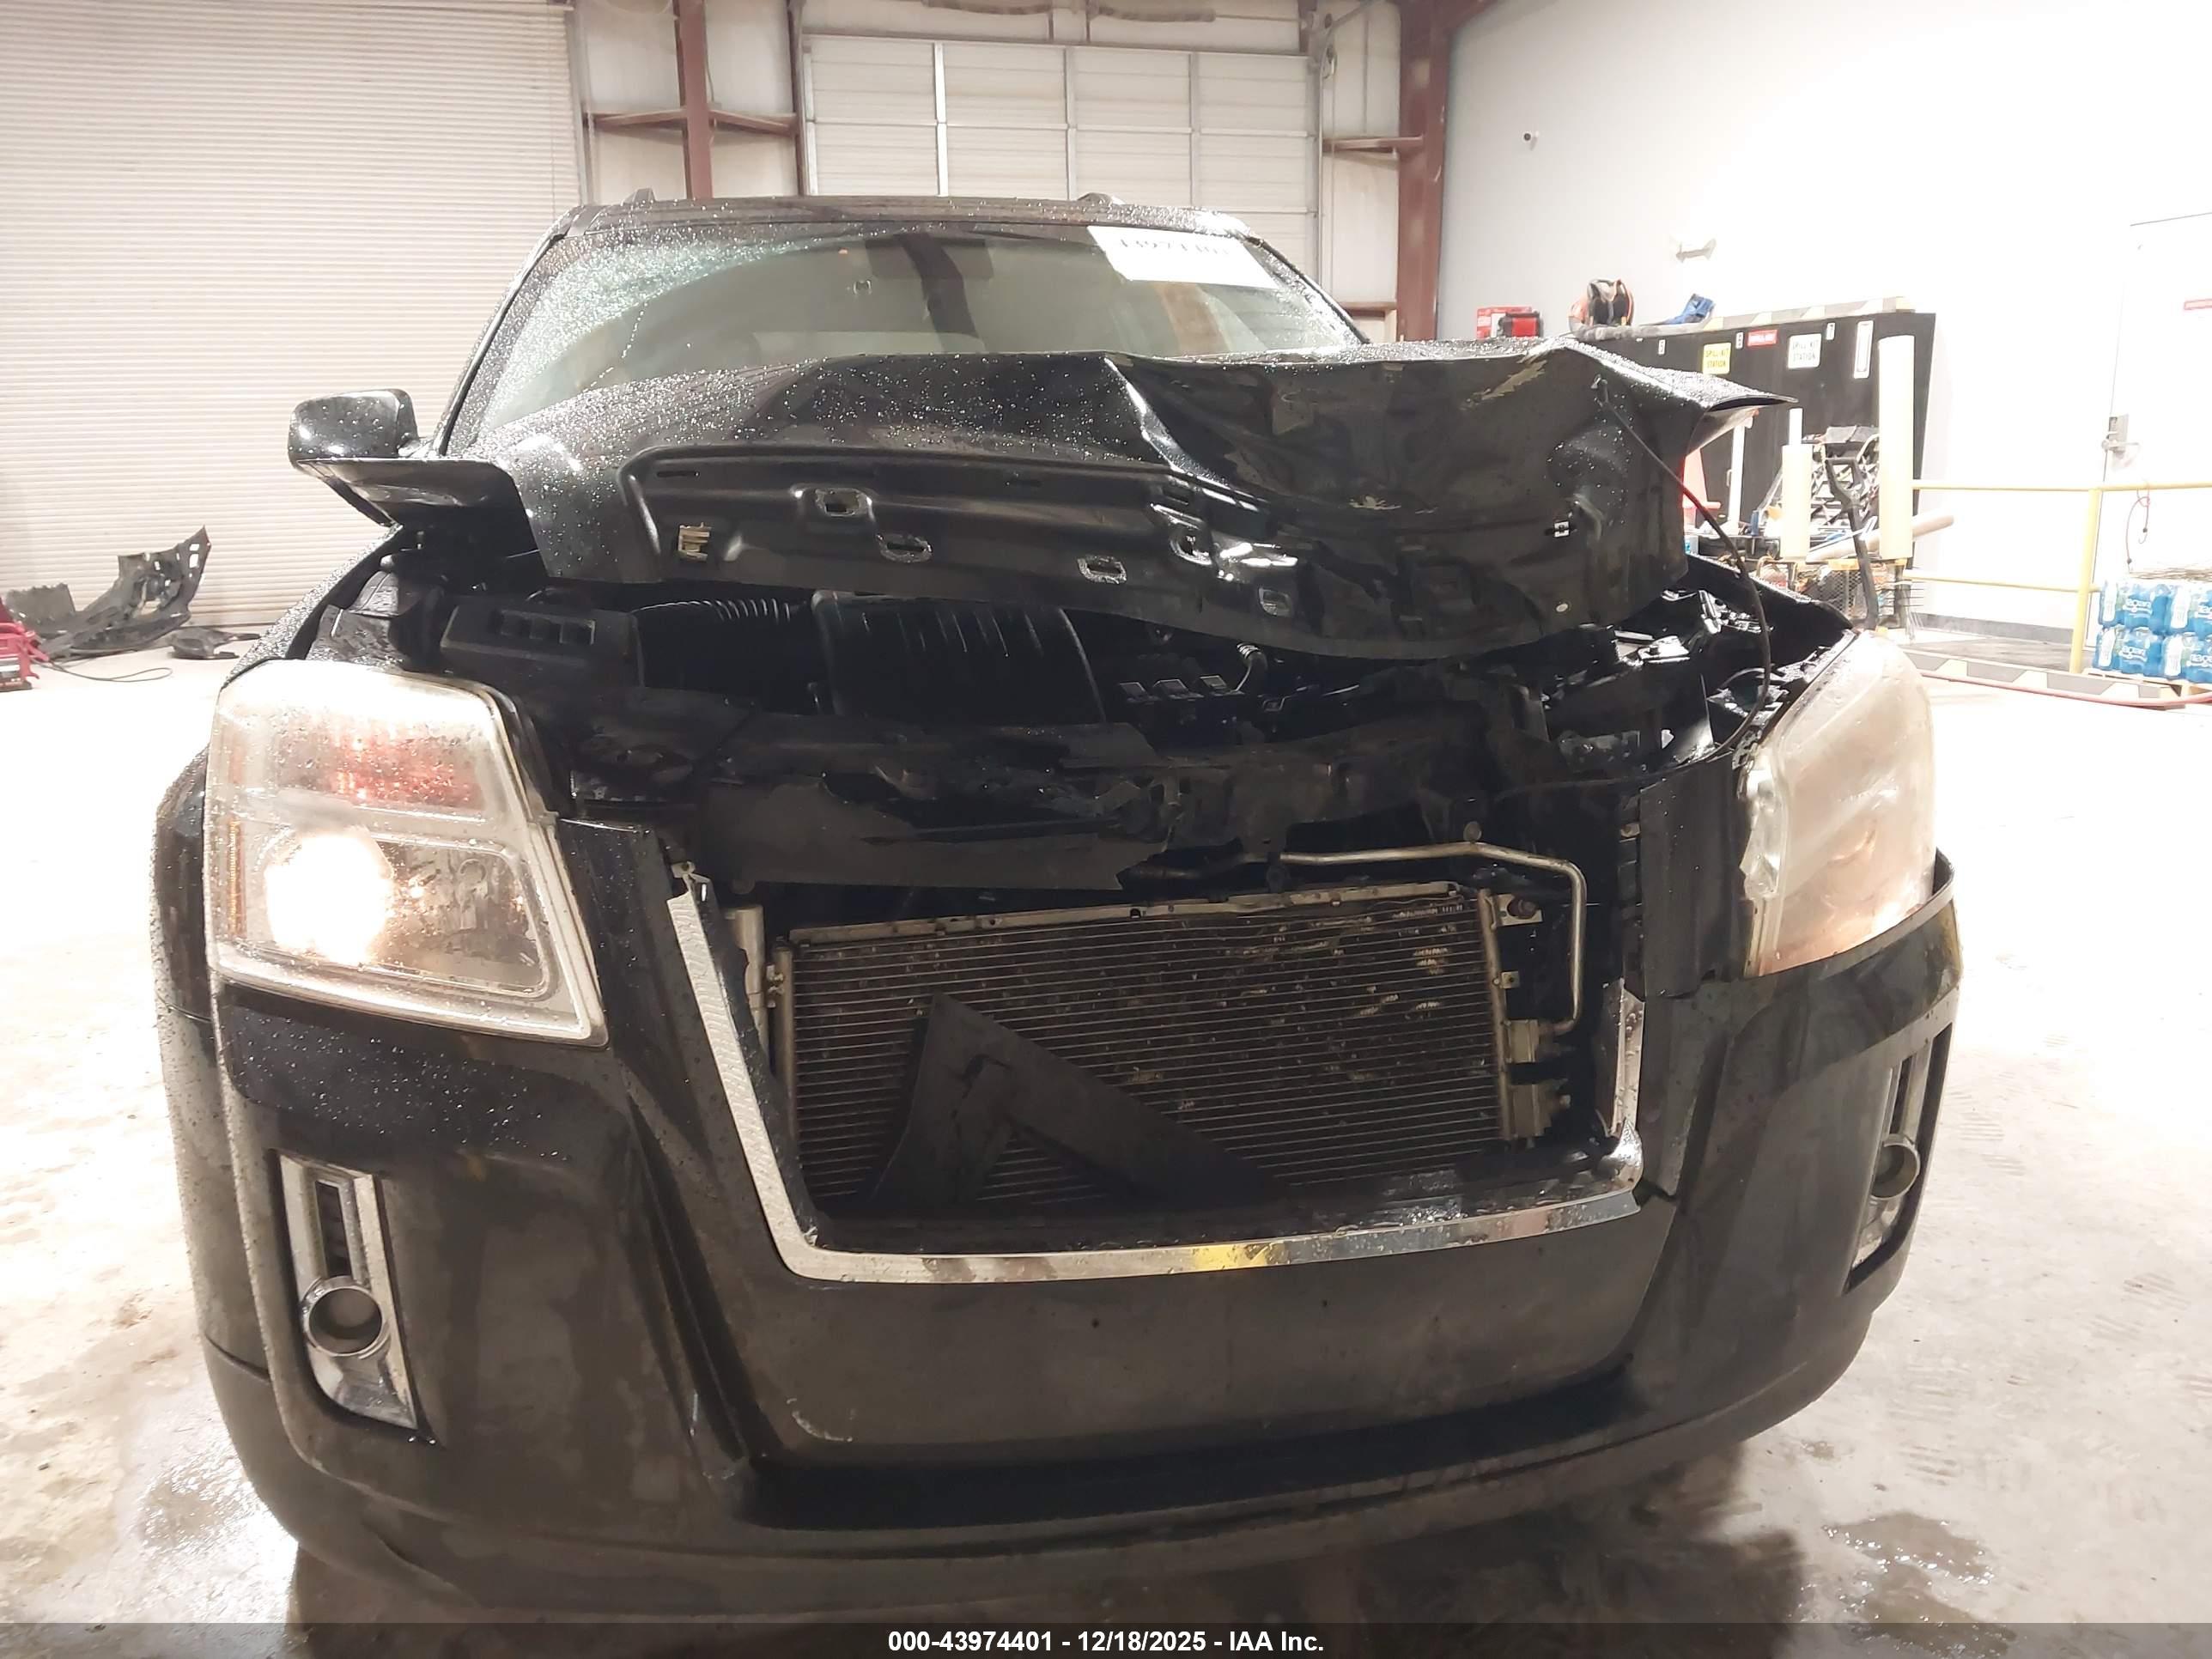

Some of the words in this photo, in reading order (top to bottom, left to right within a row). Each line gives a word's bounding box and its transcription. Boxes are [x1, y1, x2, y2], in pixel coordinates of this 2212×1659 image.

[1705, 349, 1721, 358] SPILL
[1793, 351, 1815, 362] STATION
[1707, 359, 1726, 368] STATION
